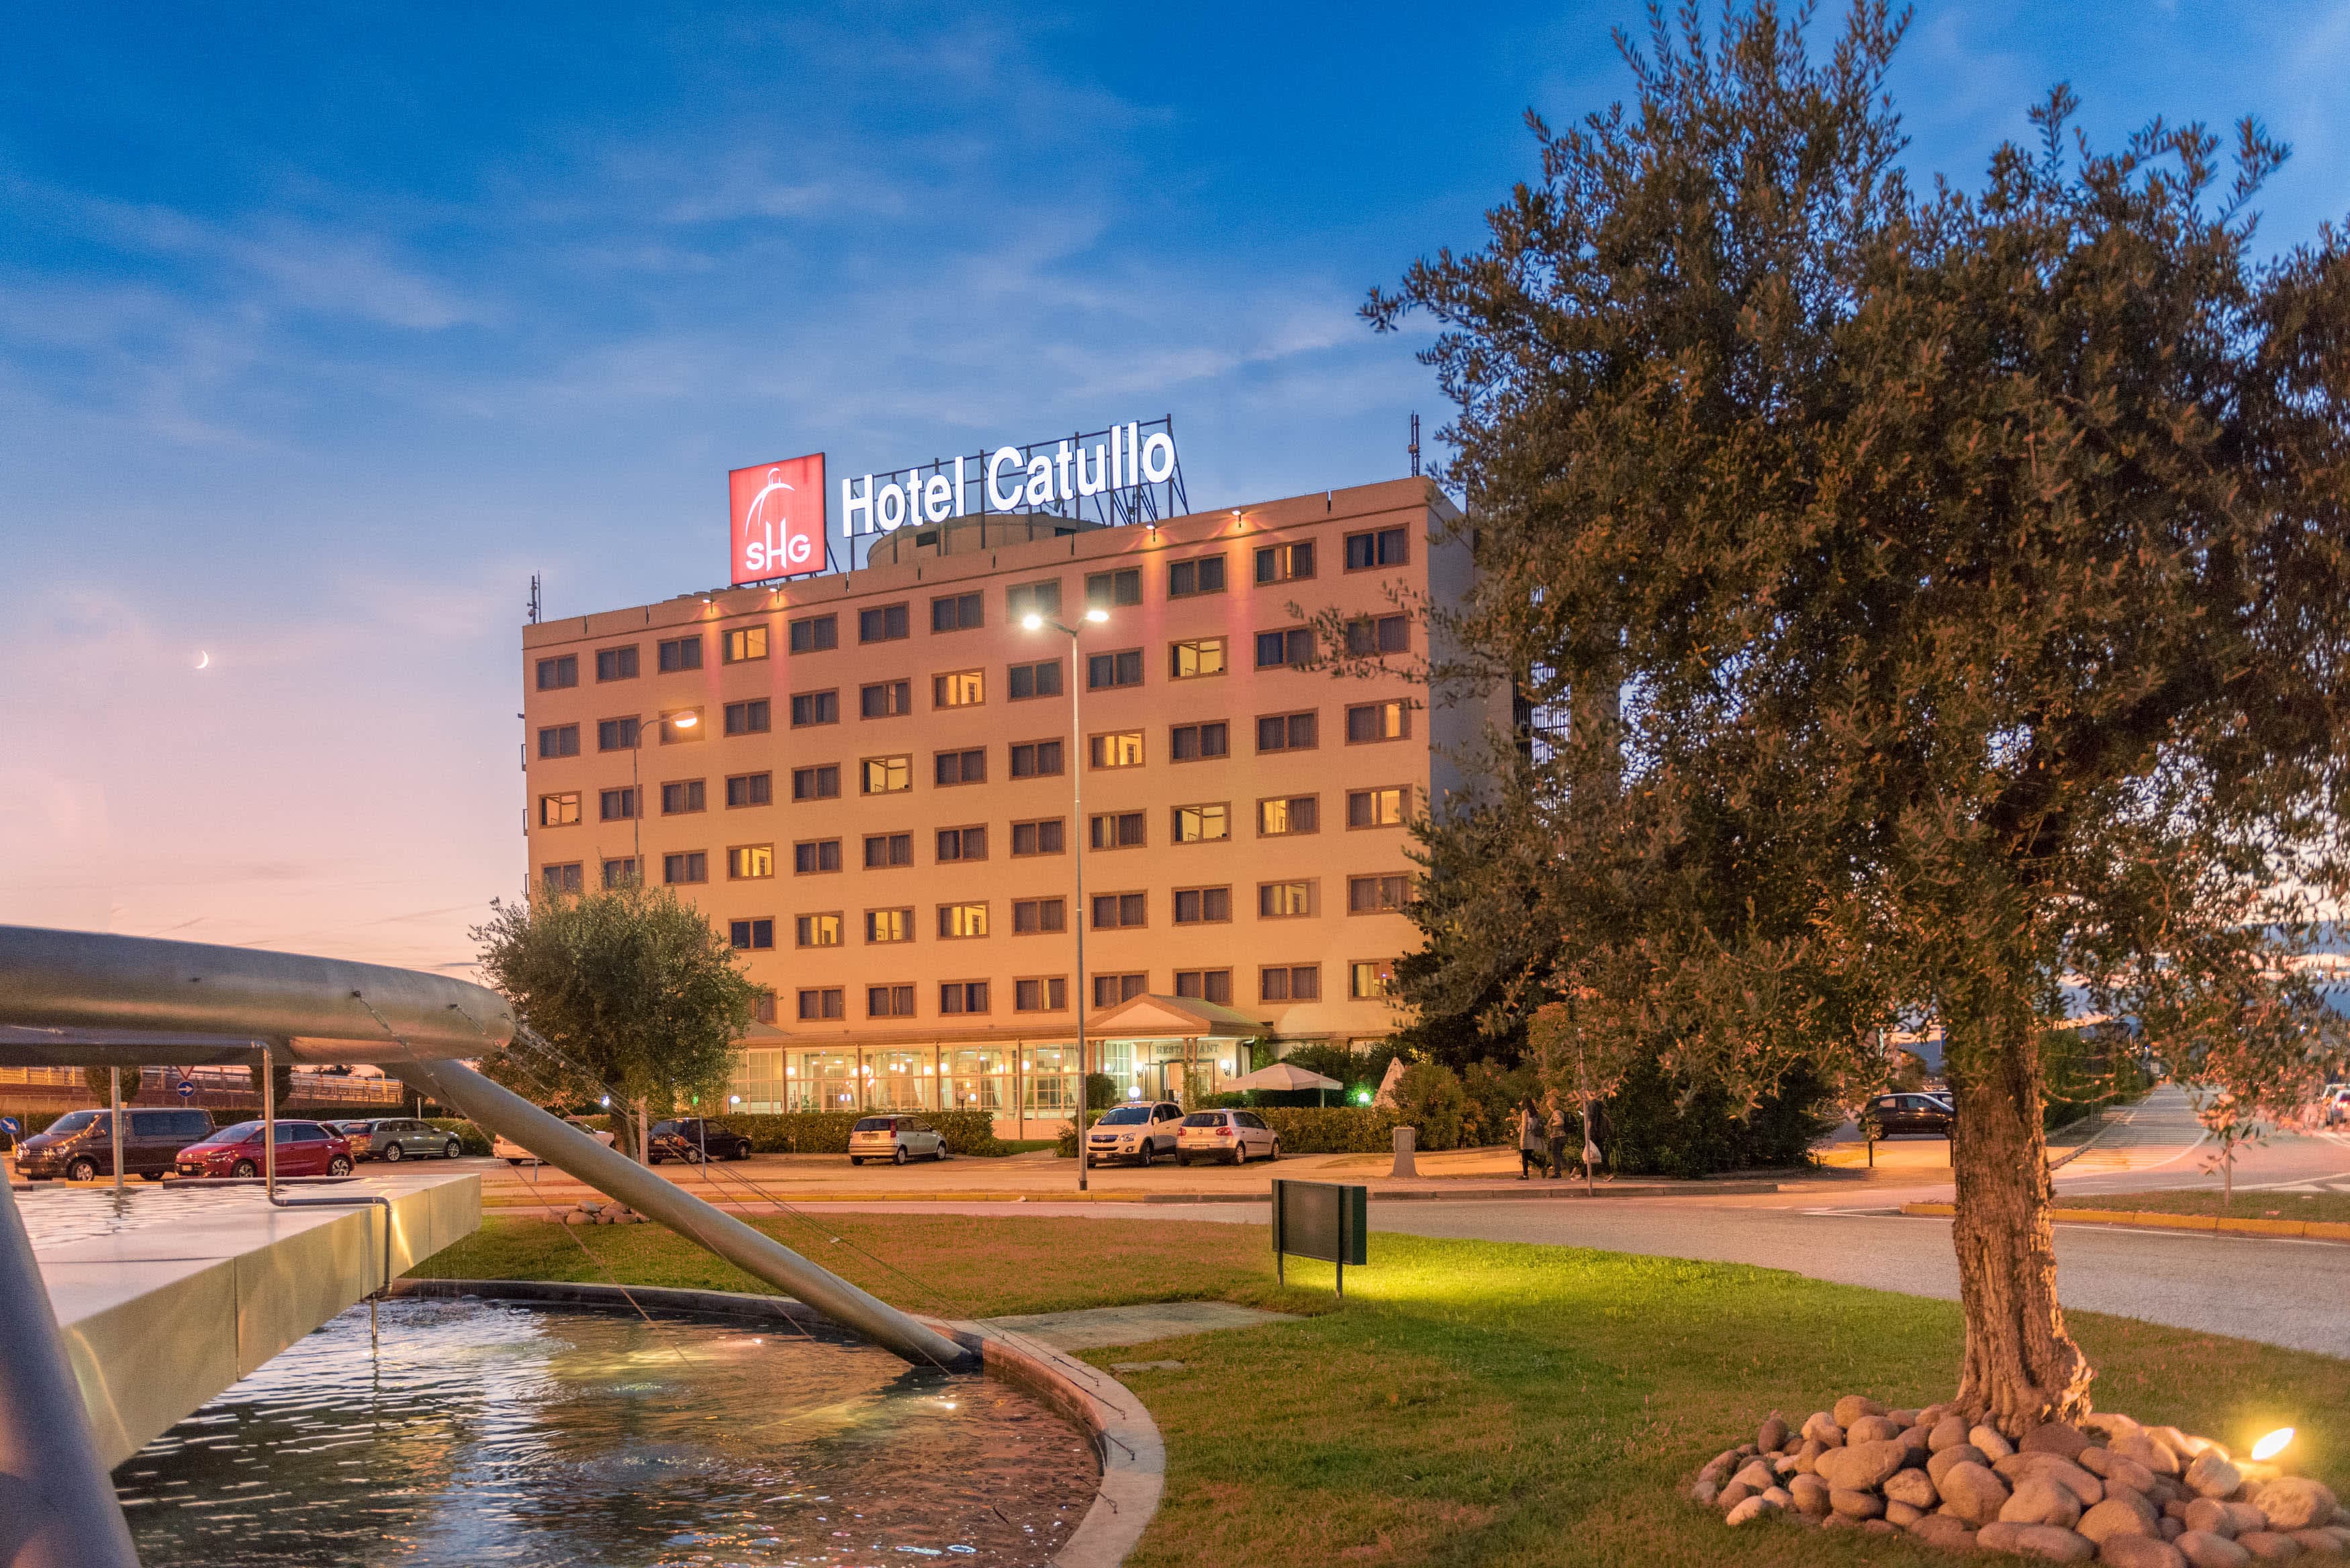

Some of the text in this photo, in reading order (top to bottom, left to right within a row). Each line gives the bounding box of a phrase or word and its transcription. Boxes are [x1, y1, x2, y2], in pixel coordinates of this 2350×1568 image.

[841, 421, 1175, 538] Hotel Catullo
[745, 516, 811, 573] SHG
[1156, 1044, 1219, 1055] RESTAUANT
